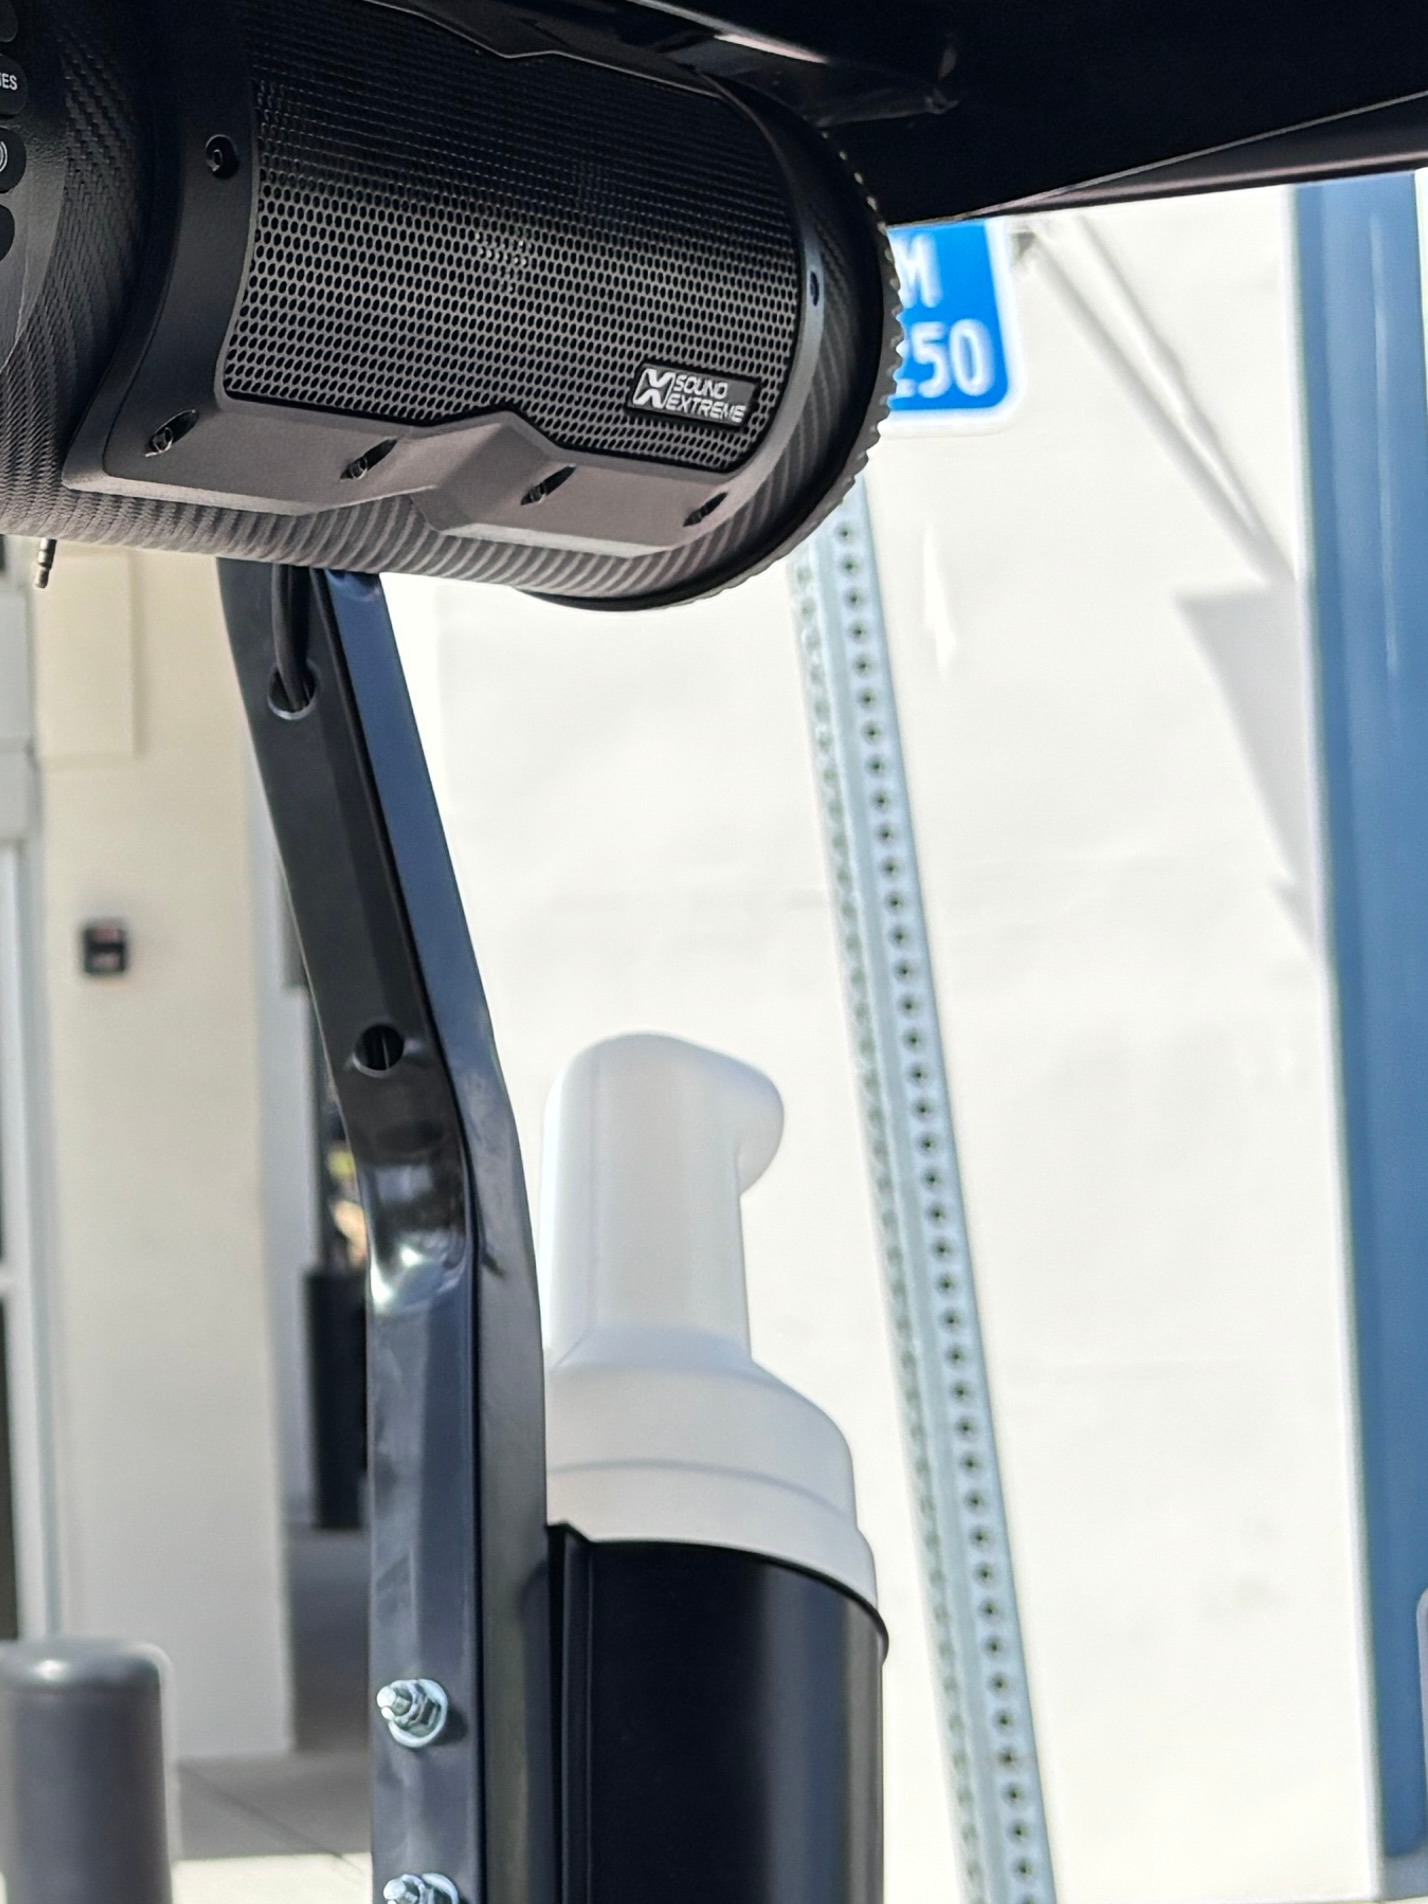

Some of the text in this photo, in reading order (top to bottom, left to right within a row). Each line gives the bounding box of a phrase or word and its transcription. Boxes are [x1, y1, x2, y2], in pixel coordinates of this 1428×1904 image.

[895, 318, 995, 399] 50
[673, 374, 729, 400] SOUND
[665, 392, 748, 424] EXTREME
